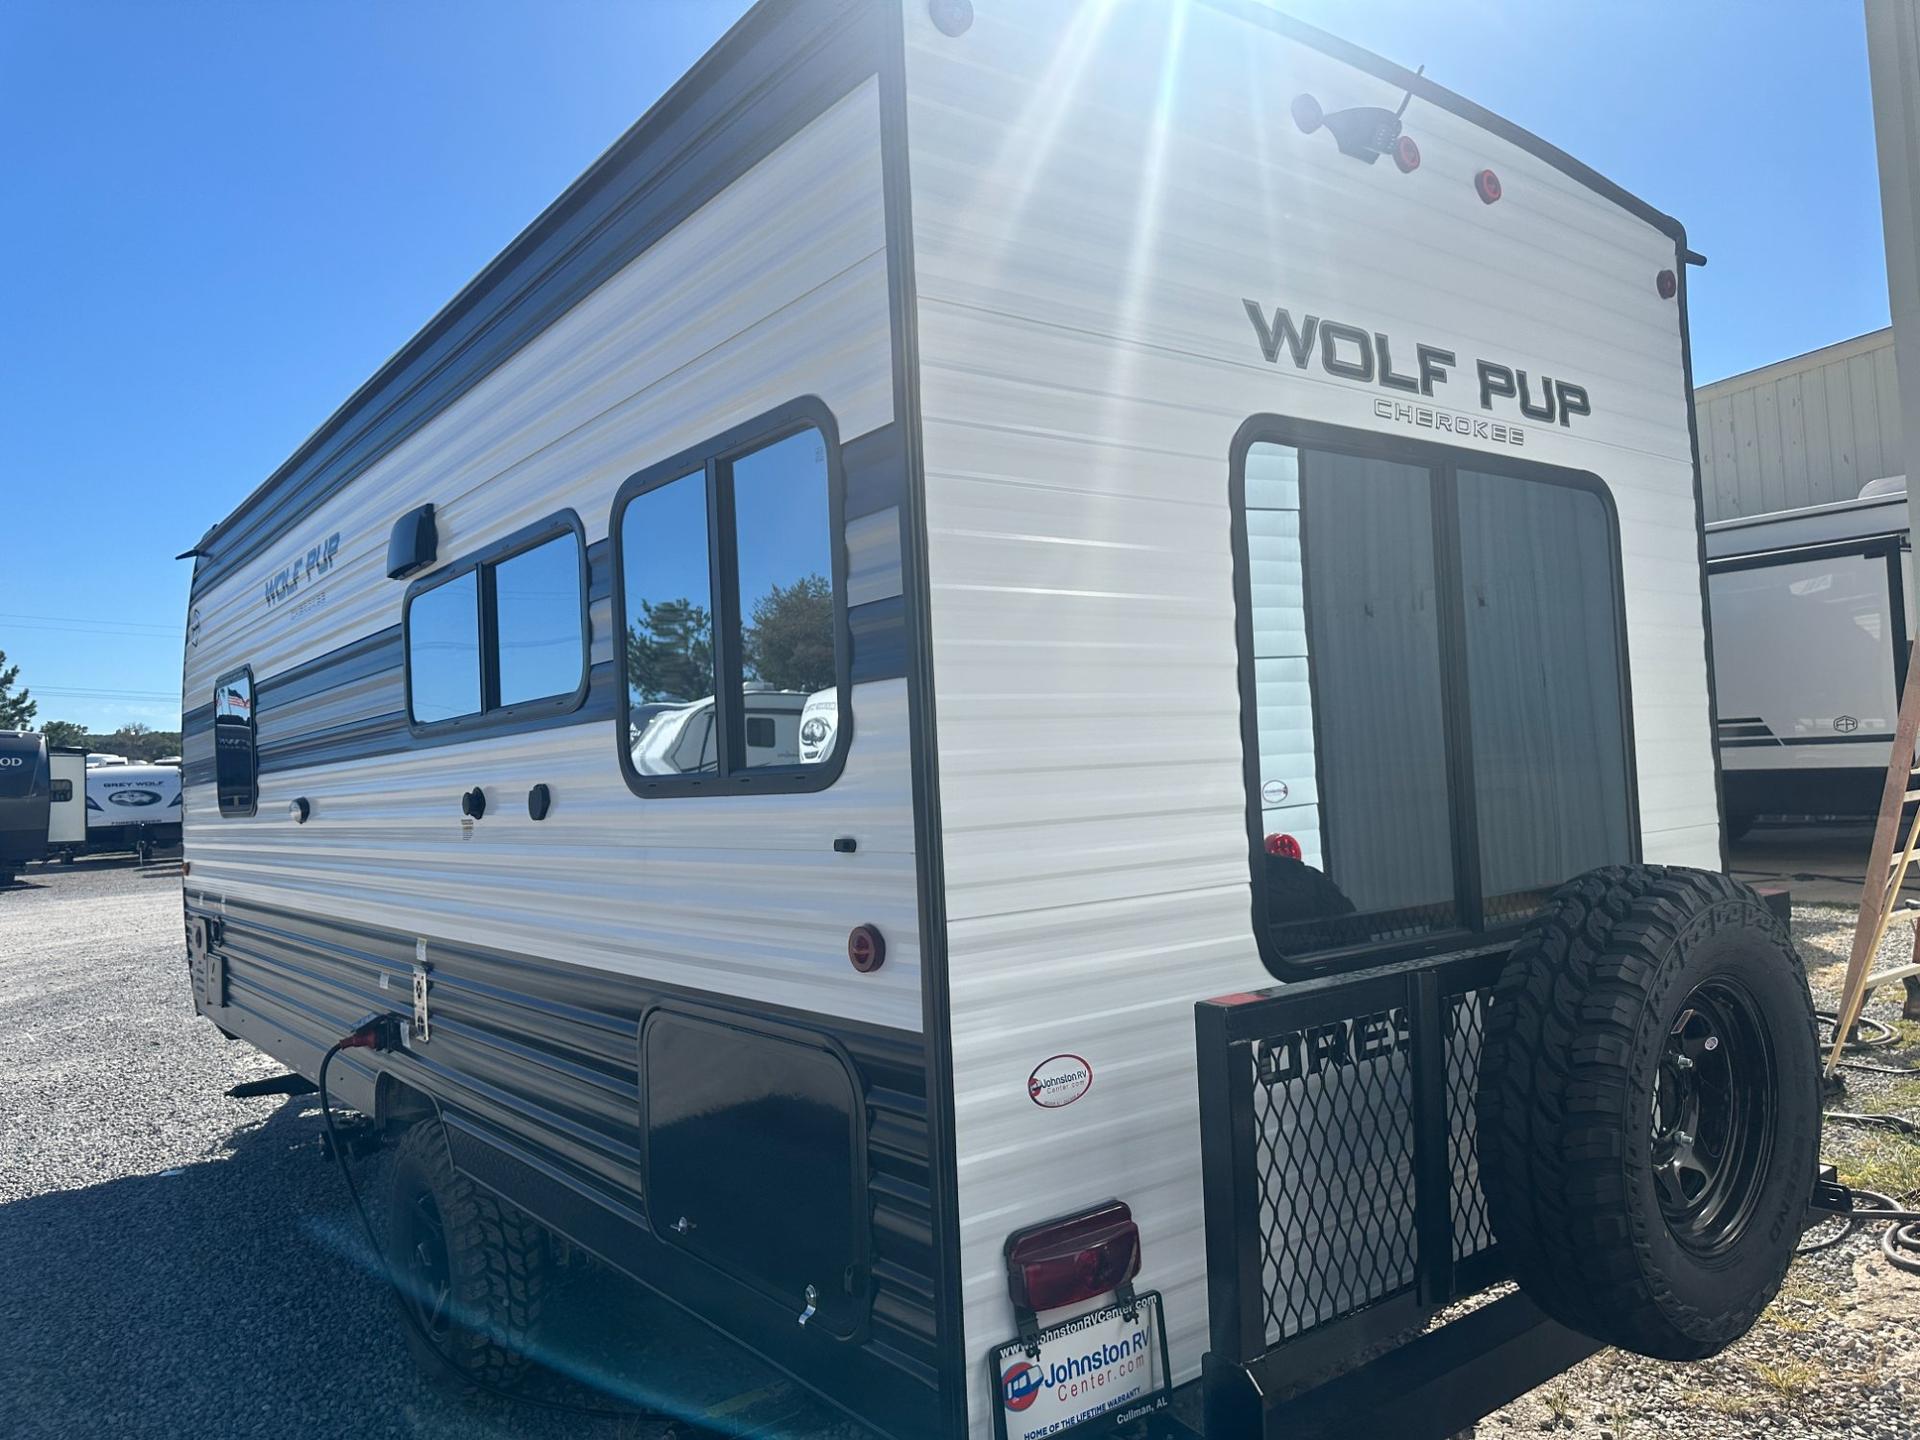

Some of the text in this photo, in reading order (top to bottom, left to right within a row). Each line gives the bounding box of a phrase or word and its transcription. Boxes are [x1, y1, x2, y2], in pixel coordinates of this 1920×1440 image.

[1242, 298, 1592, 427] WOLF PUP
[1374, 399, 1525, 446] CHEROKEE
[265, 557, 303, 607] WOLF
[306, 532, 340, 582] PUP
[1040, 1069, 1087, 1089] Johnston RV
[1044, 1326, 1151, 1388] Johnston RV
[1057, 1354, 1145, 1401] Center.com
[1023, 1386, 1142, 1440] HOME OF THE LIFETIME WARRANTY
[1116, 1396, 1168, 1425] Cullman, AL
